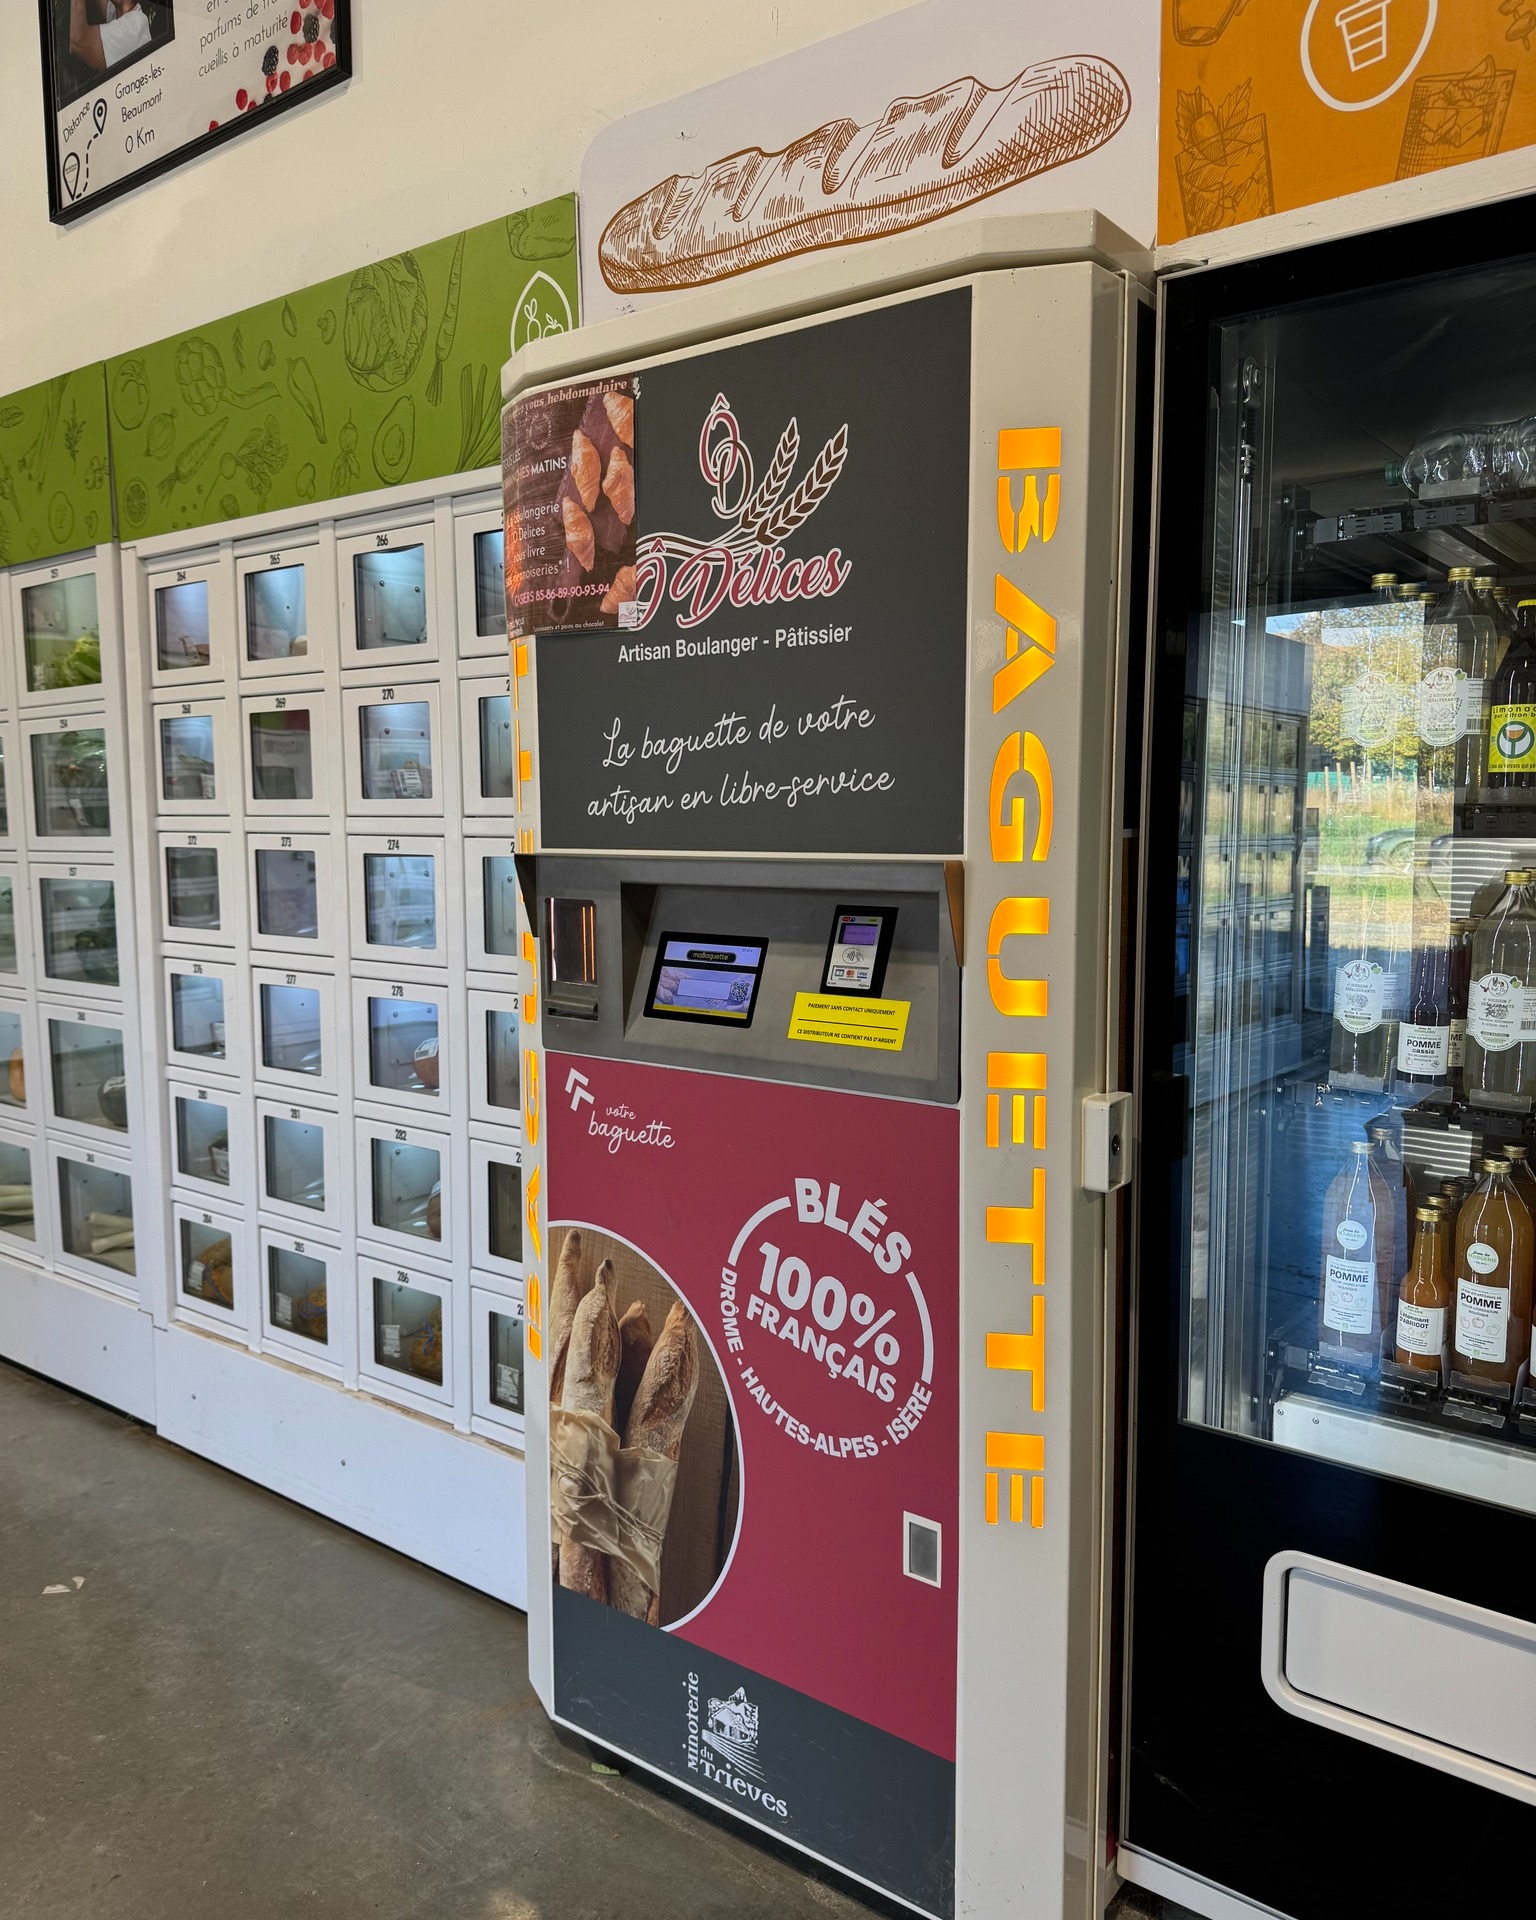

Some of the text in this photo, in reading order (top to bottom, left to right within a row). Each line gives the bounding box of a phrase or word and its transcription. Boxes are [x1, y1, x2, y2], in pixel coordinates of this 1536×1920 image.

[200, 0, 259, 54] parfums de
[198, 10, 288, 77] cueillis à maturité
[115, 63, 165, 99] Granges-les-
[120, 88, 163, 123] Beaumont
[62, 101, 91, 143] Distance
[136, 126, 155, 148] Km
[547, 379, 628, 404] hebdomadaire
[531, 456, 567, 476] MATINS
[376, 534, 388, 547] 266
[519, 524, 546, 542] Délices
[270, 553, 280, 565] 265
[527, 545, 546, 559] livre
[515, 583, 610, 607] CASIERS 85-86-89-90-93-94
[670, 547, 853, 629] Délices
[618, 643, 671, 663] Artisan
[675, 634, 758, 658] Boulanger
[775, 624, 853, 649] Pâtissier
[275, 697, 286, 708] 269
[382, 688, 394, 700] 270
[602, 694, 877, 775] La baguette de votre
[587, 768, 896, 825] artisan en libre-service
[281, 836, 291, 847] 273
[387, 839, 400, 850] 274
[286, 974, 296, 985] 277
[985, 427, 1061, 1530] BAGUETTE
[391, 985, 404, 998] 278
[808, 1002, 831, 1010] PAIEMENT
[843, 1005, 864, 1013] CONTACT
[864, 1008, 896, 1016] UNIQUEMENT
[803, 1029, 834, 1038] DISTRIBUTEUR
[841, 1033, 863, 1041] CONTIENT
[873, 1036, 897, 1044] D'ARGENT
[1406, 1039, 1441, 1049] POMME
[395, 1128, 407, 1141] 282
[587, 1103, 676, 1154] votre baguette
[795, 1177, 911, 1274] BLÉS
[294, 1240, 305, 1253] 285
[397, 1270, 409, 1284] 286
[1330, 1268, 1369, 1283] POMME
[759, 1241, 900, 1366] 100%
[1460, 1292, 1502, 1310] POMME
[746, 1293, 897, 1403] FRANÇAIS
[720, 1266, 744, 1353] DRÔME
[740, 1366, 879, 1459] HAUTES-ALPES
[885, 1381, 932, 1445] ISÈRE
[682, 1672, 699, 1773] Minoterie
[700, 1746, 714, 1761] du
